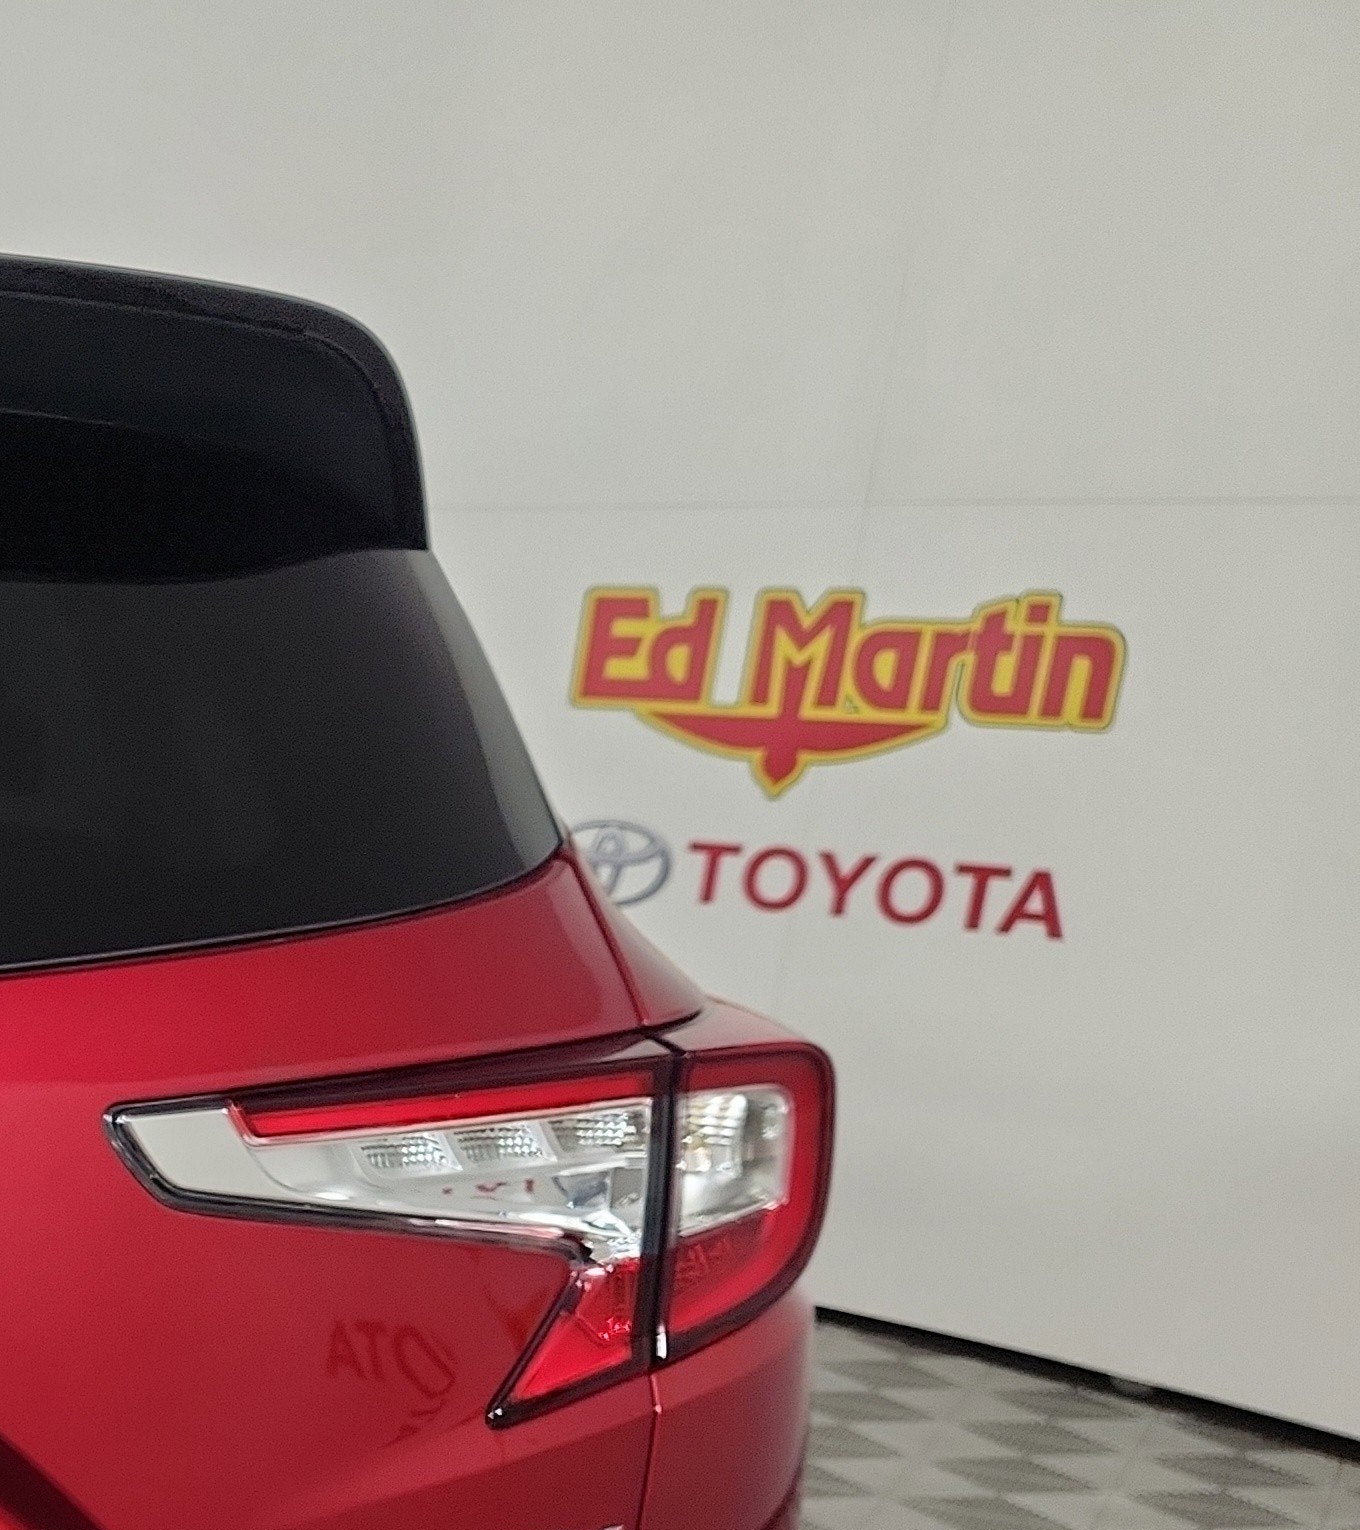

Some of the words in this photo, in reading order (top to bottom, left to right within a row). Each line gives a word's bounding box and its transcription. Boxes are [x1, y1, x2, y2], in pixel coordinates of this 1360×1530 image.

[578, 594, 722, 704] Ed
[751, 594, 1119, 721] Martin
[688, 841, 1063, 938] TOYOTA
